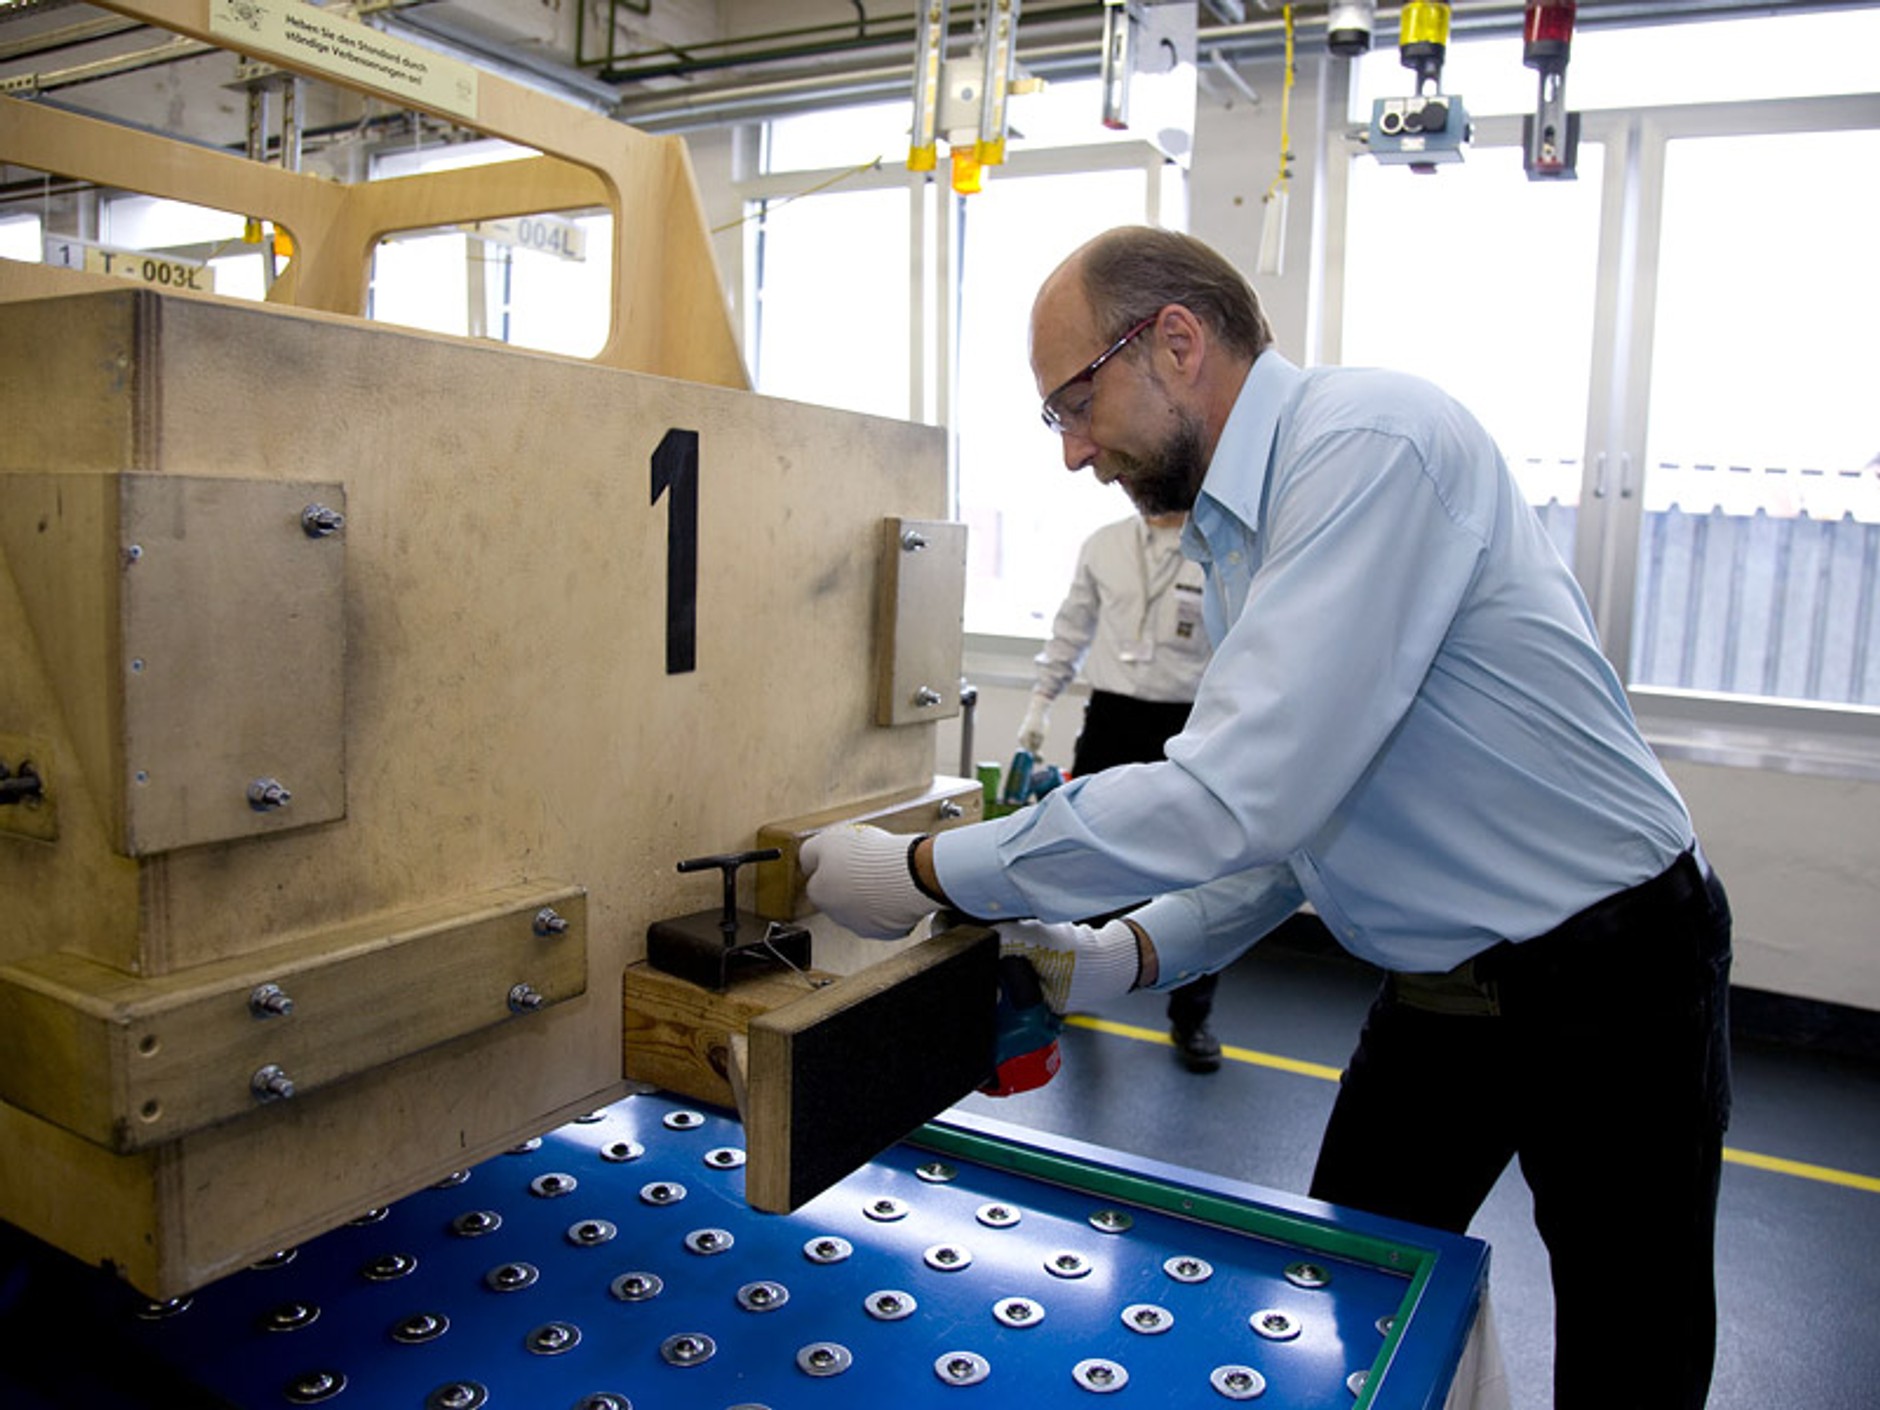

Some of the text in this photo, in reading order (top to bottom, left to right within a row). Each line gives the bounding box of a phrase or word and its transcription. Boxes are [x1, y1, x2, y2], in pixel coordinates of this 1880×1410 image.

[321, 26, 335, 41] Sie
[336, 34, 356, 48] den
[402, 58, 427, 73] durch
[59, 245, 70, 265] 1
[518, 218, 575, 256] 004L
[101, 252, 116, 274] T
[143, 260, 202, 289] 003L
[650, 427, 699, 675] 1
